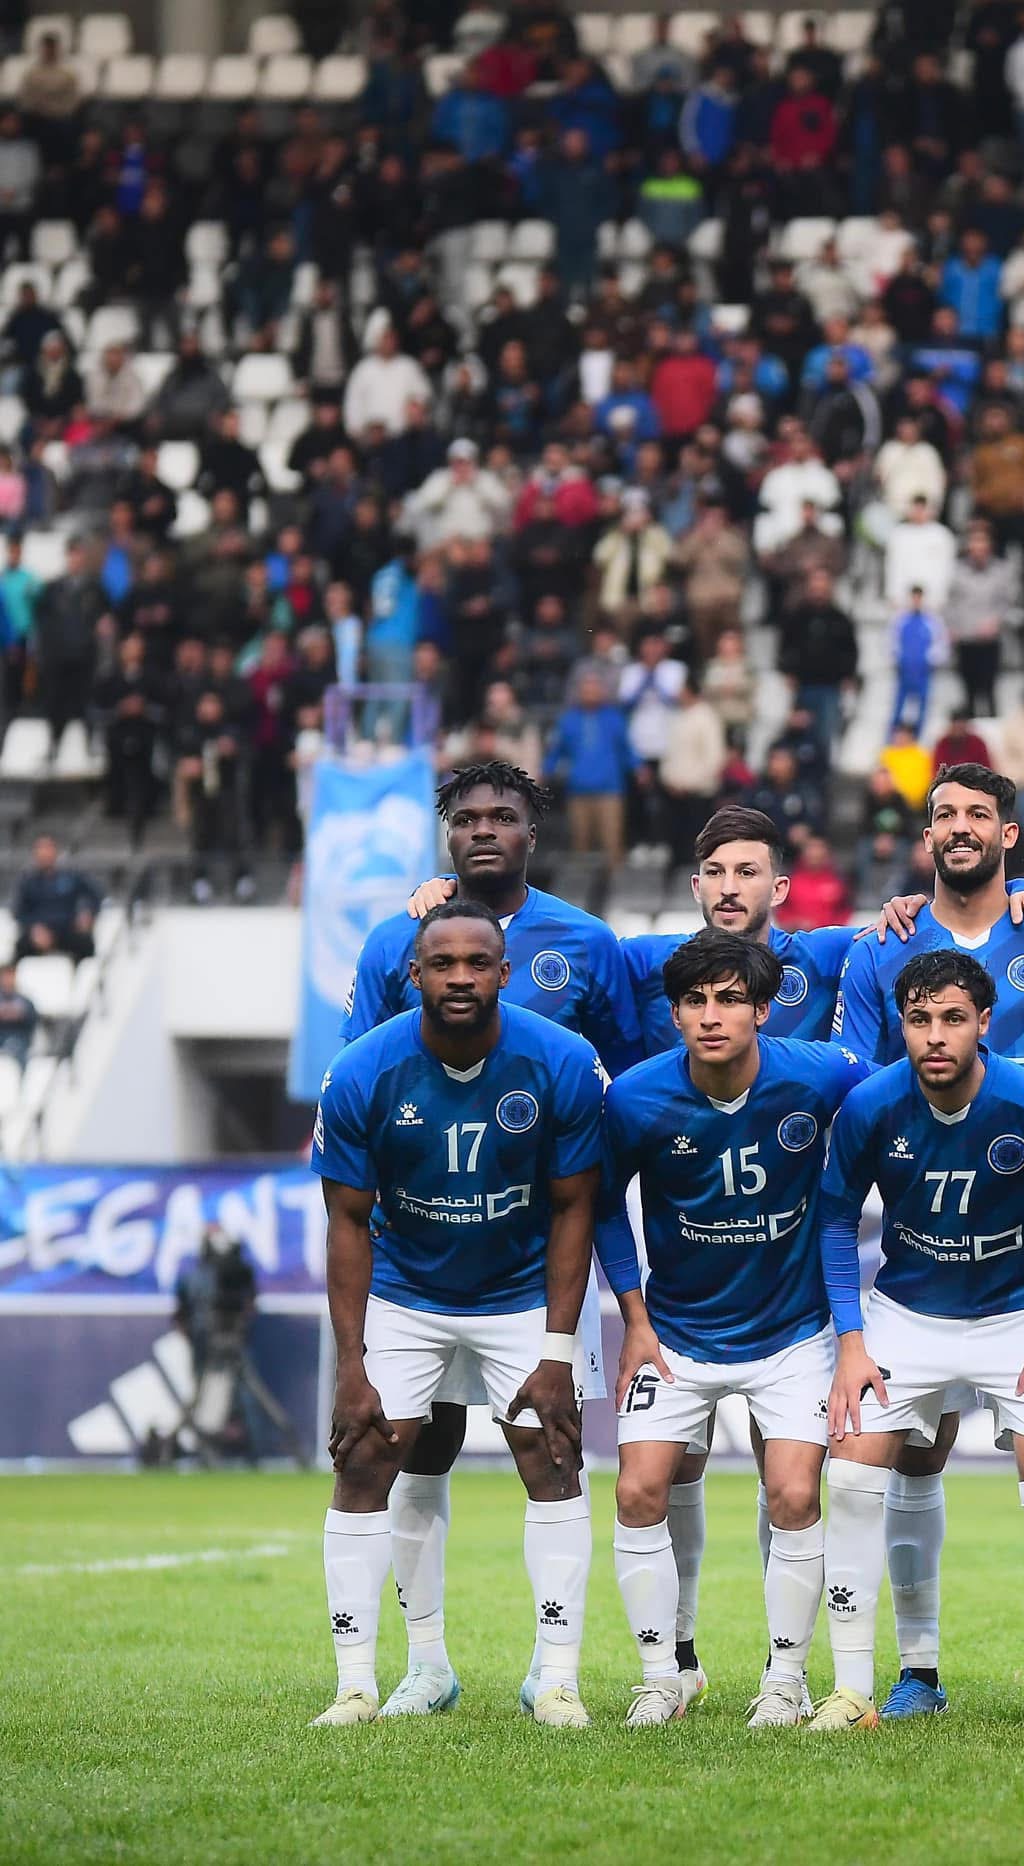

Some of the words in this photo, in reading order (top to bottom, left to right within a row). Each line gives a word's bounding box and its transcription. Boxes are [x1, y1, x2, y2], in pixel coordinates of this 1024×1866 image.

[396, 1118, 424, 1126] KELME
[443, 1122, 488, 1172] 17
[718, 1141, 767, 1196] 15
[396, 1188, 482, 1207] المنصة
[925, 1170, 976, 1214] 77
[399, 1201, 483, 1224] Almanasa
[678, 1211, 765, 1229] المنصة
[0, 1173, 328, 1291] EGANT
[681, 1227, 767, 1244] Almanasa
[893, 1221, 970, 1247] المنصة
[898, 1231, 971, 1262] Almanasa
[626, 1374, 660, 1413] 15
[827, 1602, 857, 1612] KELME
[540, 1618, 568, 1626] KELME
